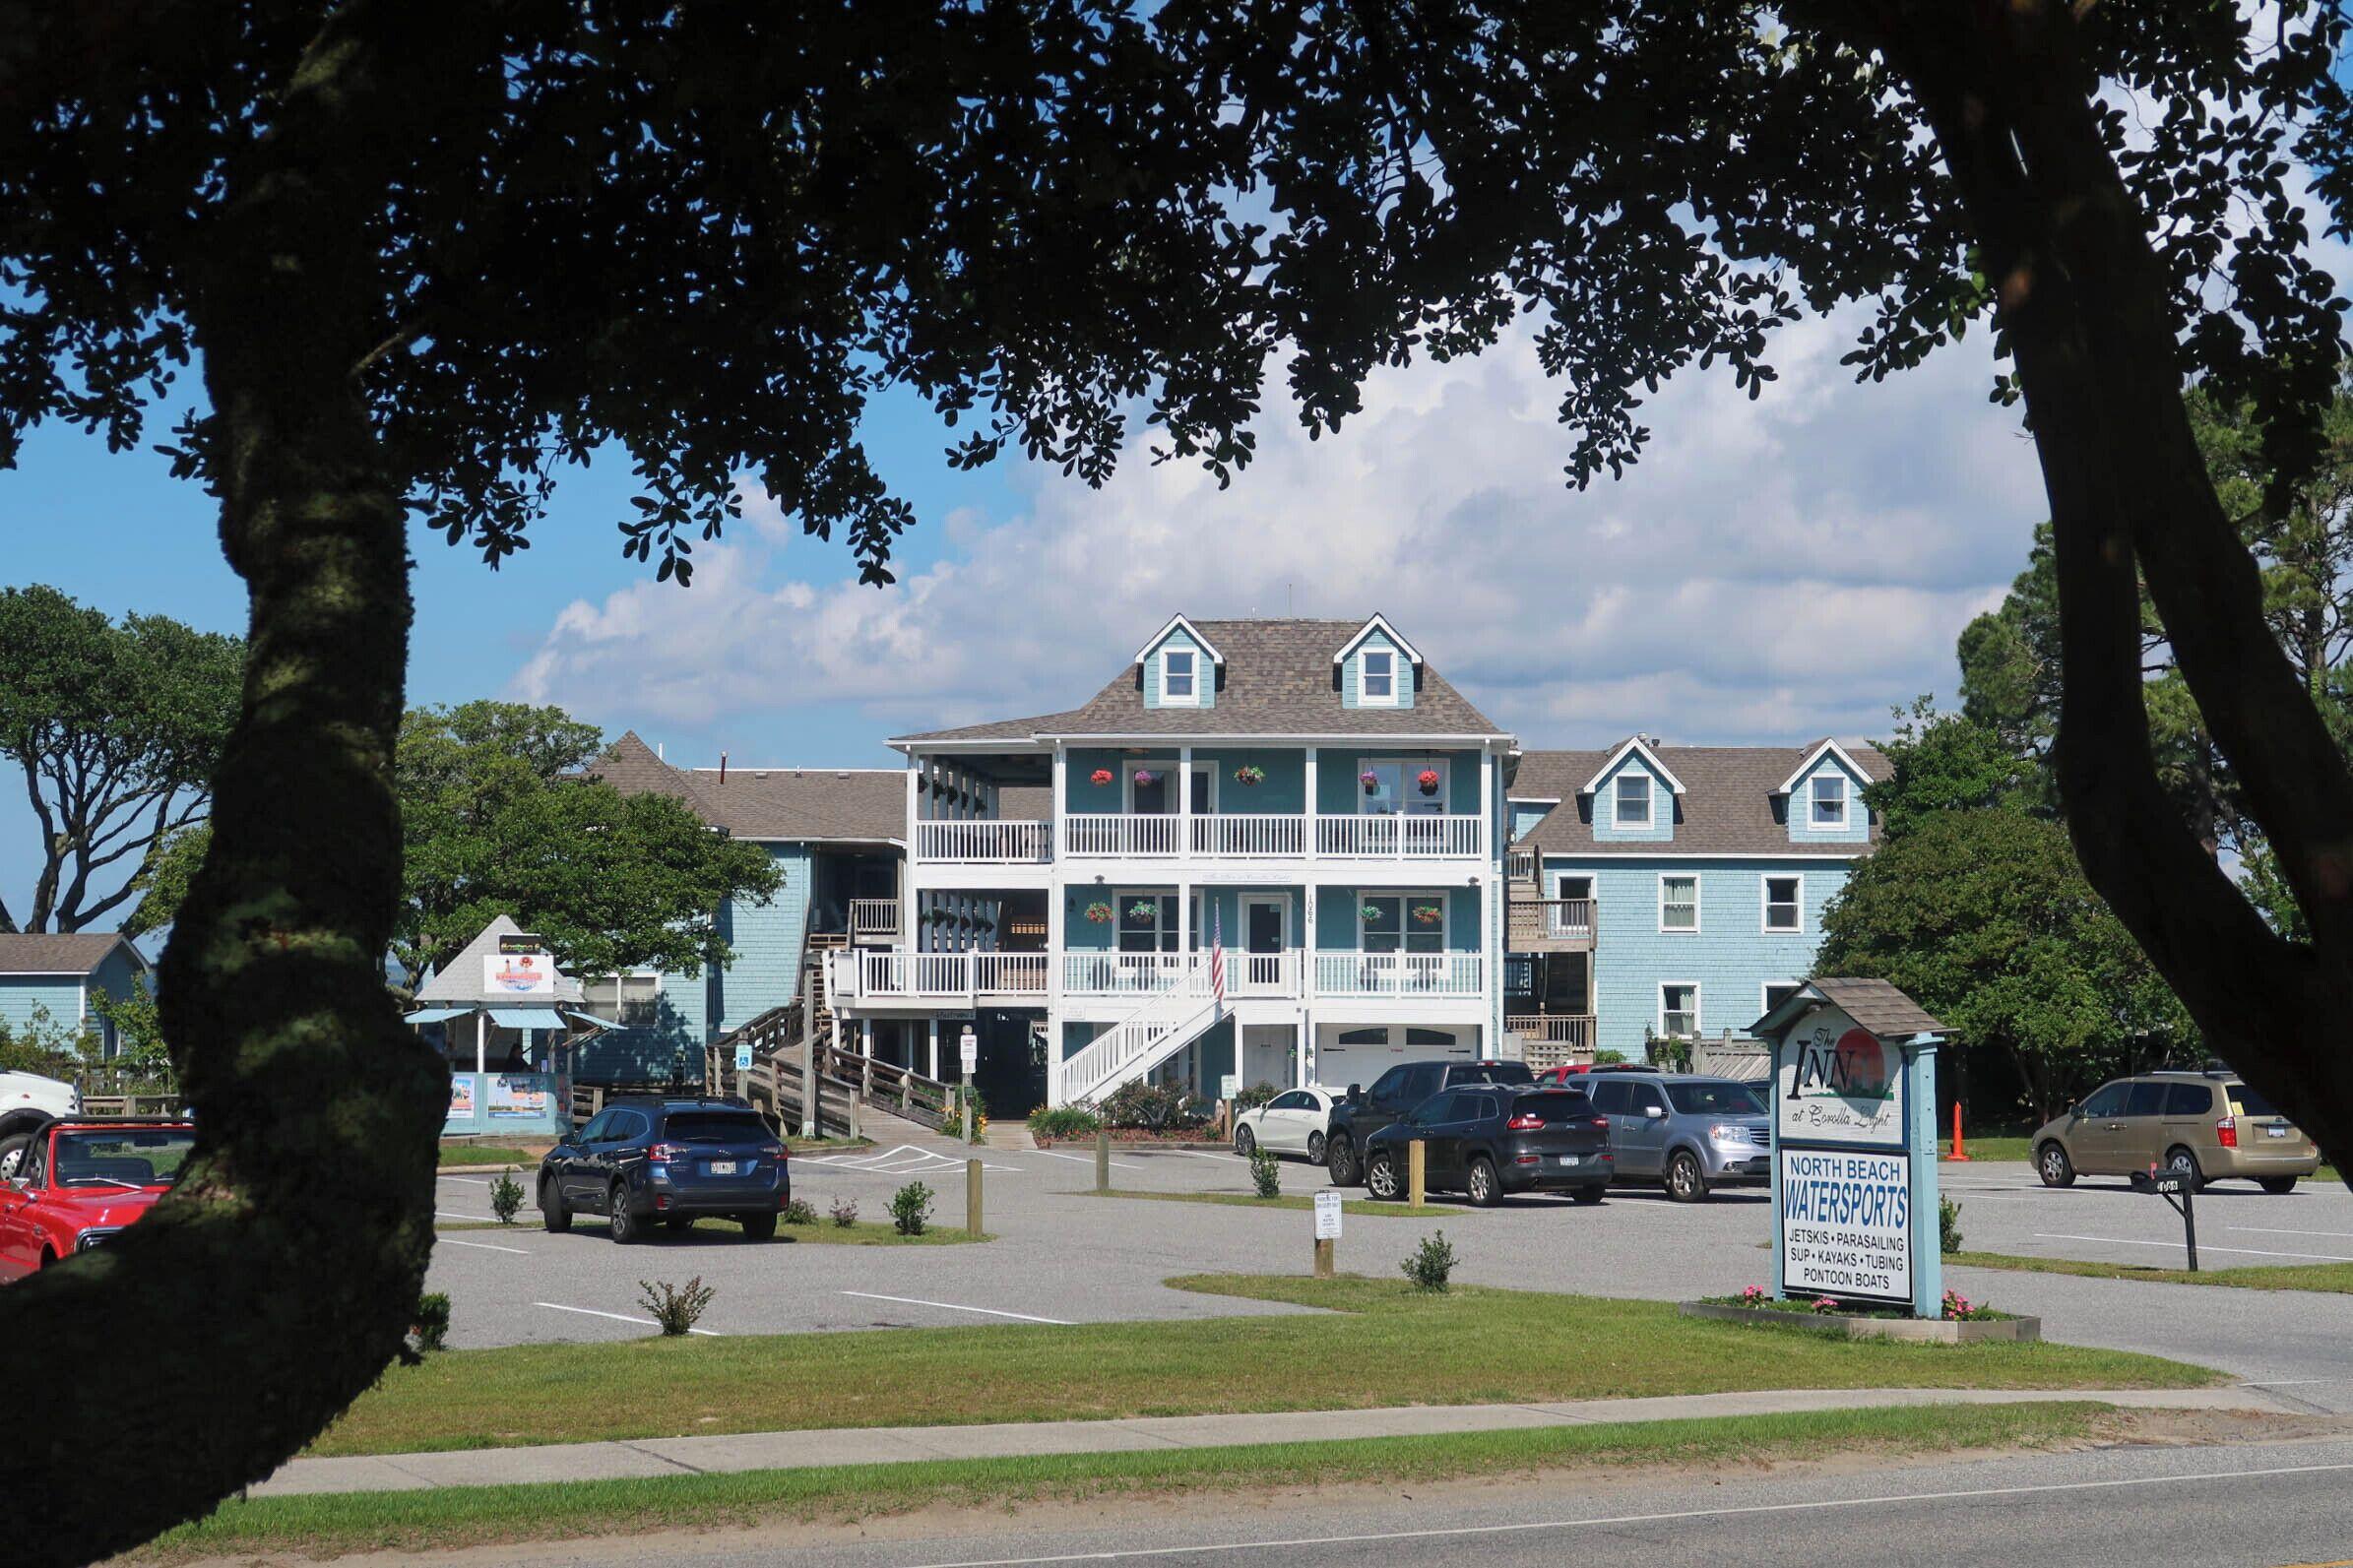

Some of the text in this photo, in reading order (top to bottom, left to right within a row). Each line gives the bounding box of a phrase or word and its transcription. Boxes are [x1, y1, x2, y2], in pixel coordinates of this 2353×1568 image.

[1813, 1028, 1835, 1046] The
[1787, 1040, 1856, 1099] INN
[1792, 1104, 1891, 1134] at Corolla Light
[1791, 1157, 1900, 1181] NORTH BEACH
[1785, 1179, 1907, 1228] WATERSPORTS
[1789, 1228, 1904, 1252] JETSKIS PARASAILING
[1791, 1247, 1903, 1272] SUP KAYAKS TUBING
[1804, 1268, 1889, 1289] PONTOON BOATS
